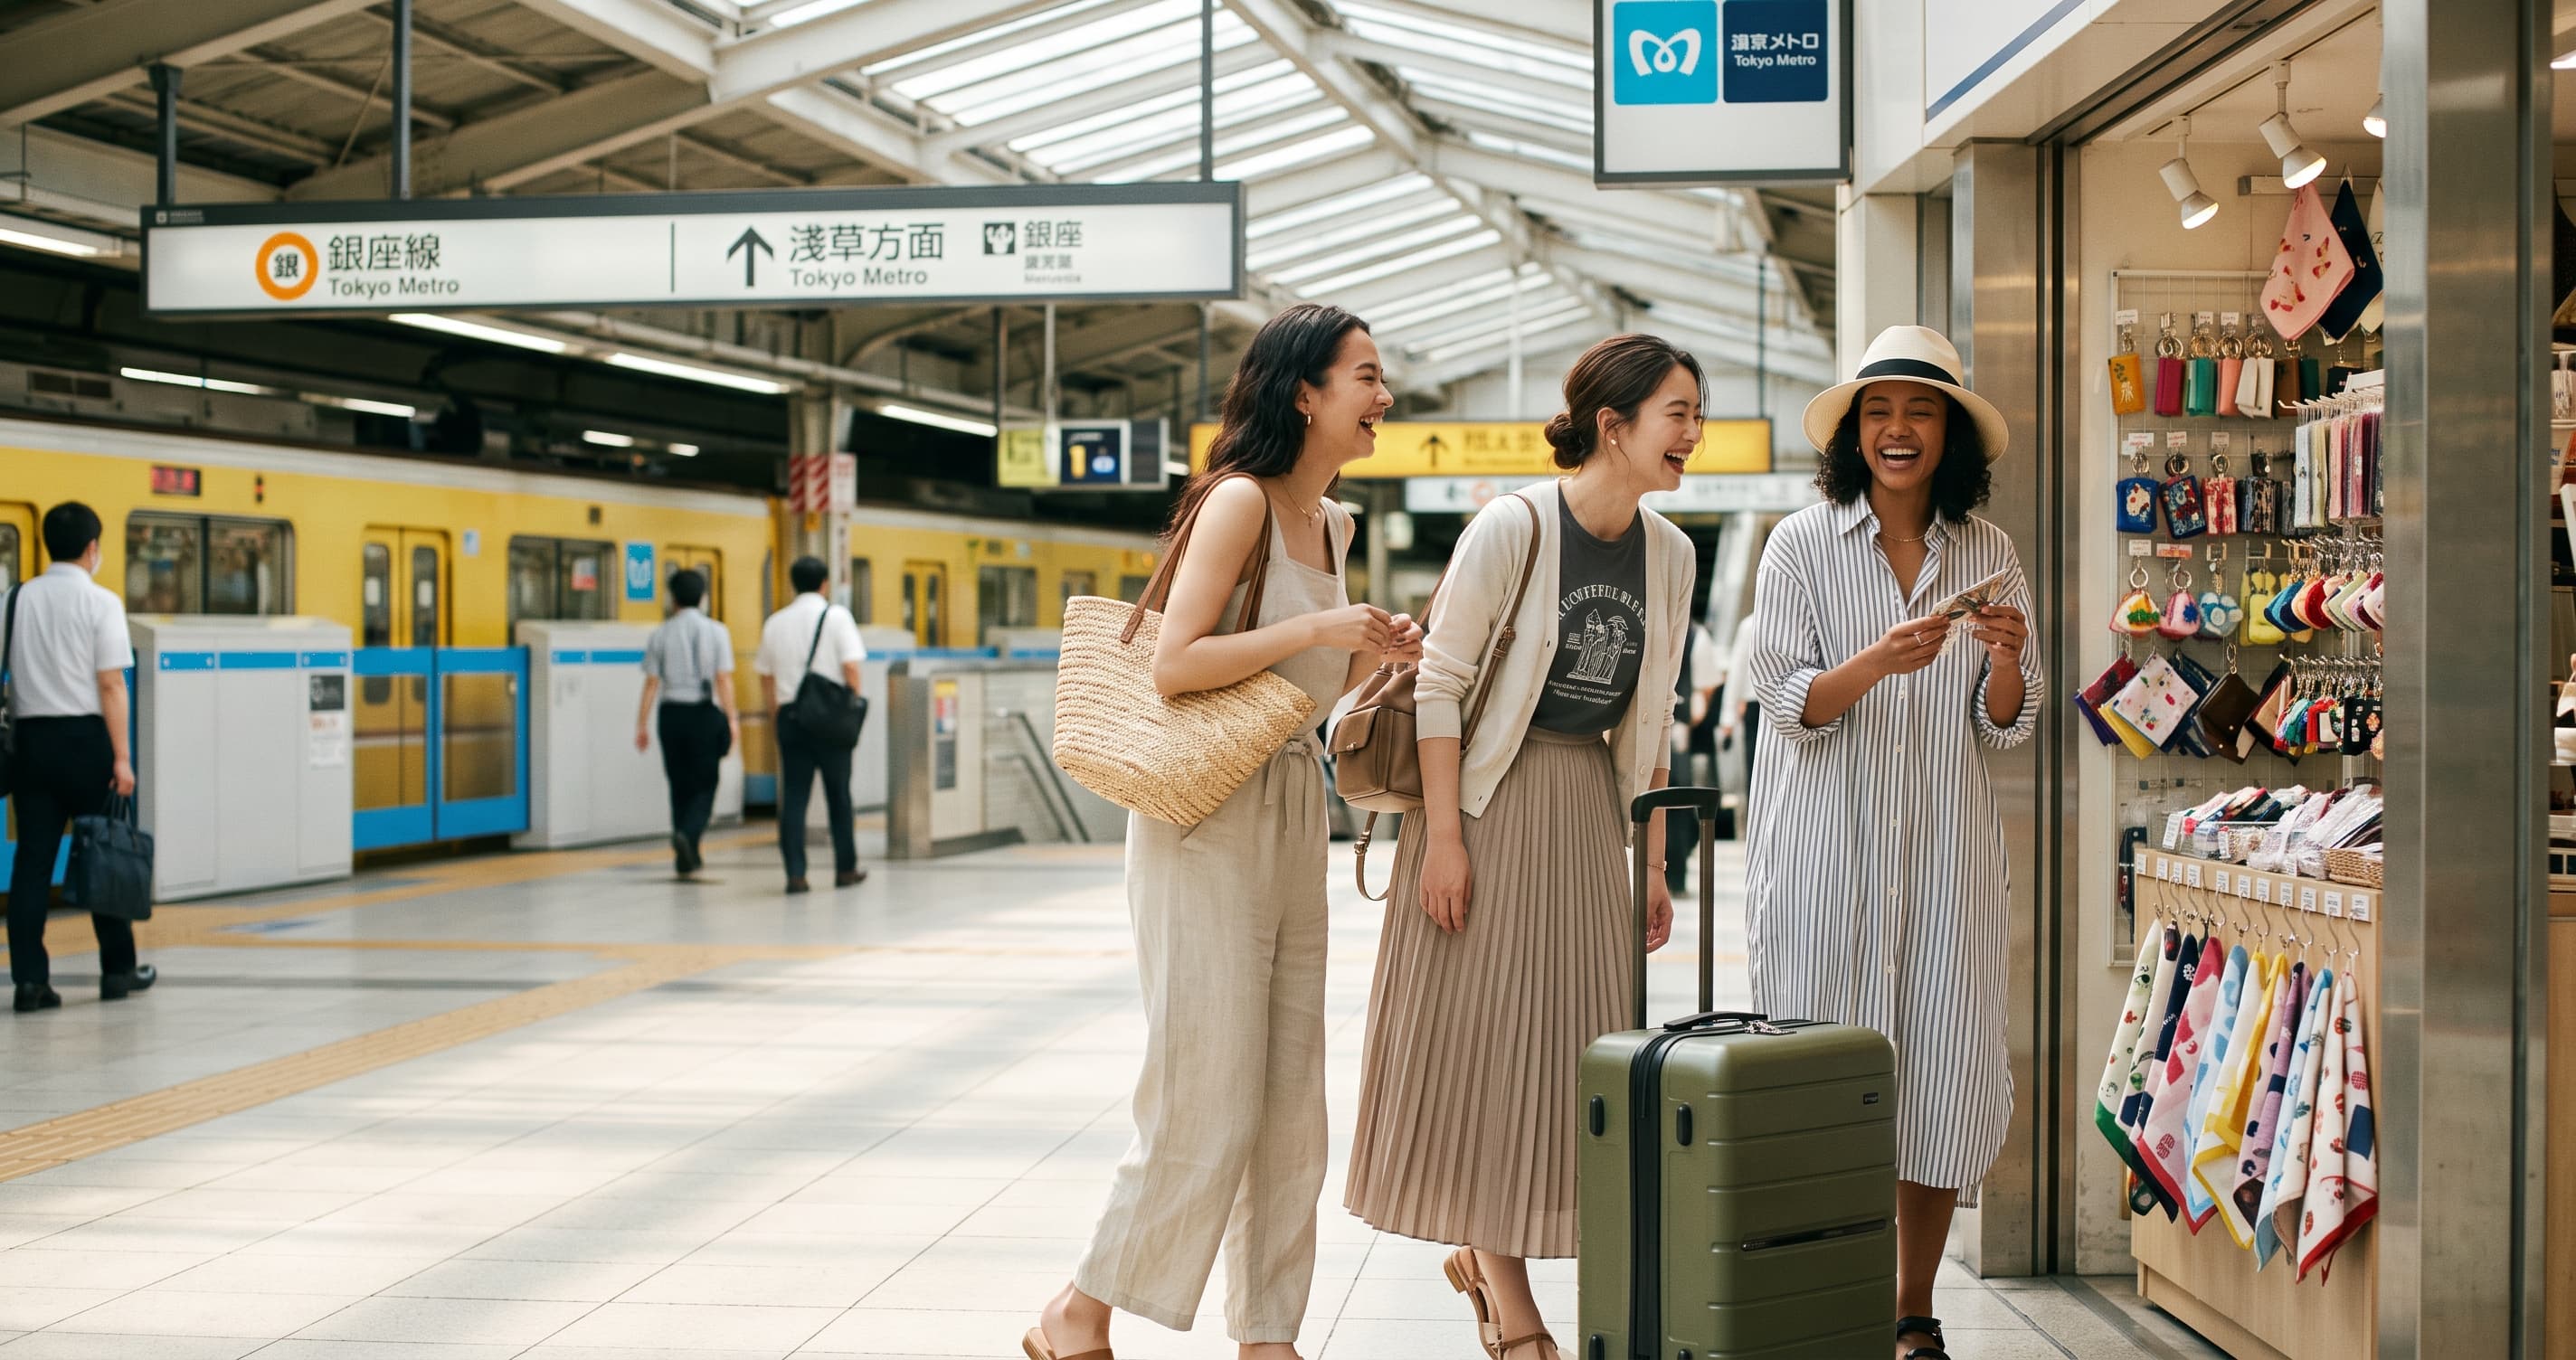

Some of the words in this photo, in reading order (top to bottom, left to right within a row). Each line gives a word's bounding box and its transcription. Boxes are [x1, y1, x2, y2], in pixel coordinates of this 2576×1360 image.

[1734, 54, 1774, 70] Tokyo
[1776, 54, 1817, 66] Metro
[1024, 220, 1083, 249] 銀座
[328, 233, 440, 271] 銀座線
[275, 253, 298, 278] 銀
[328, 278, 392, 300] Tokyo
[398, 276, 460, 295] Metro
[790, 268, 857, 291] Tokyo
[864, 267, 928, 285] Metro
